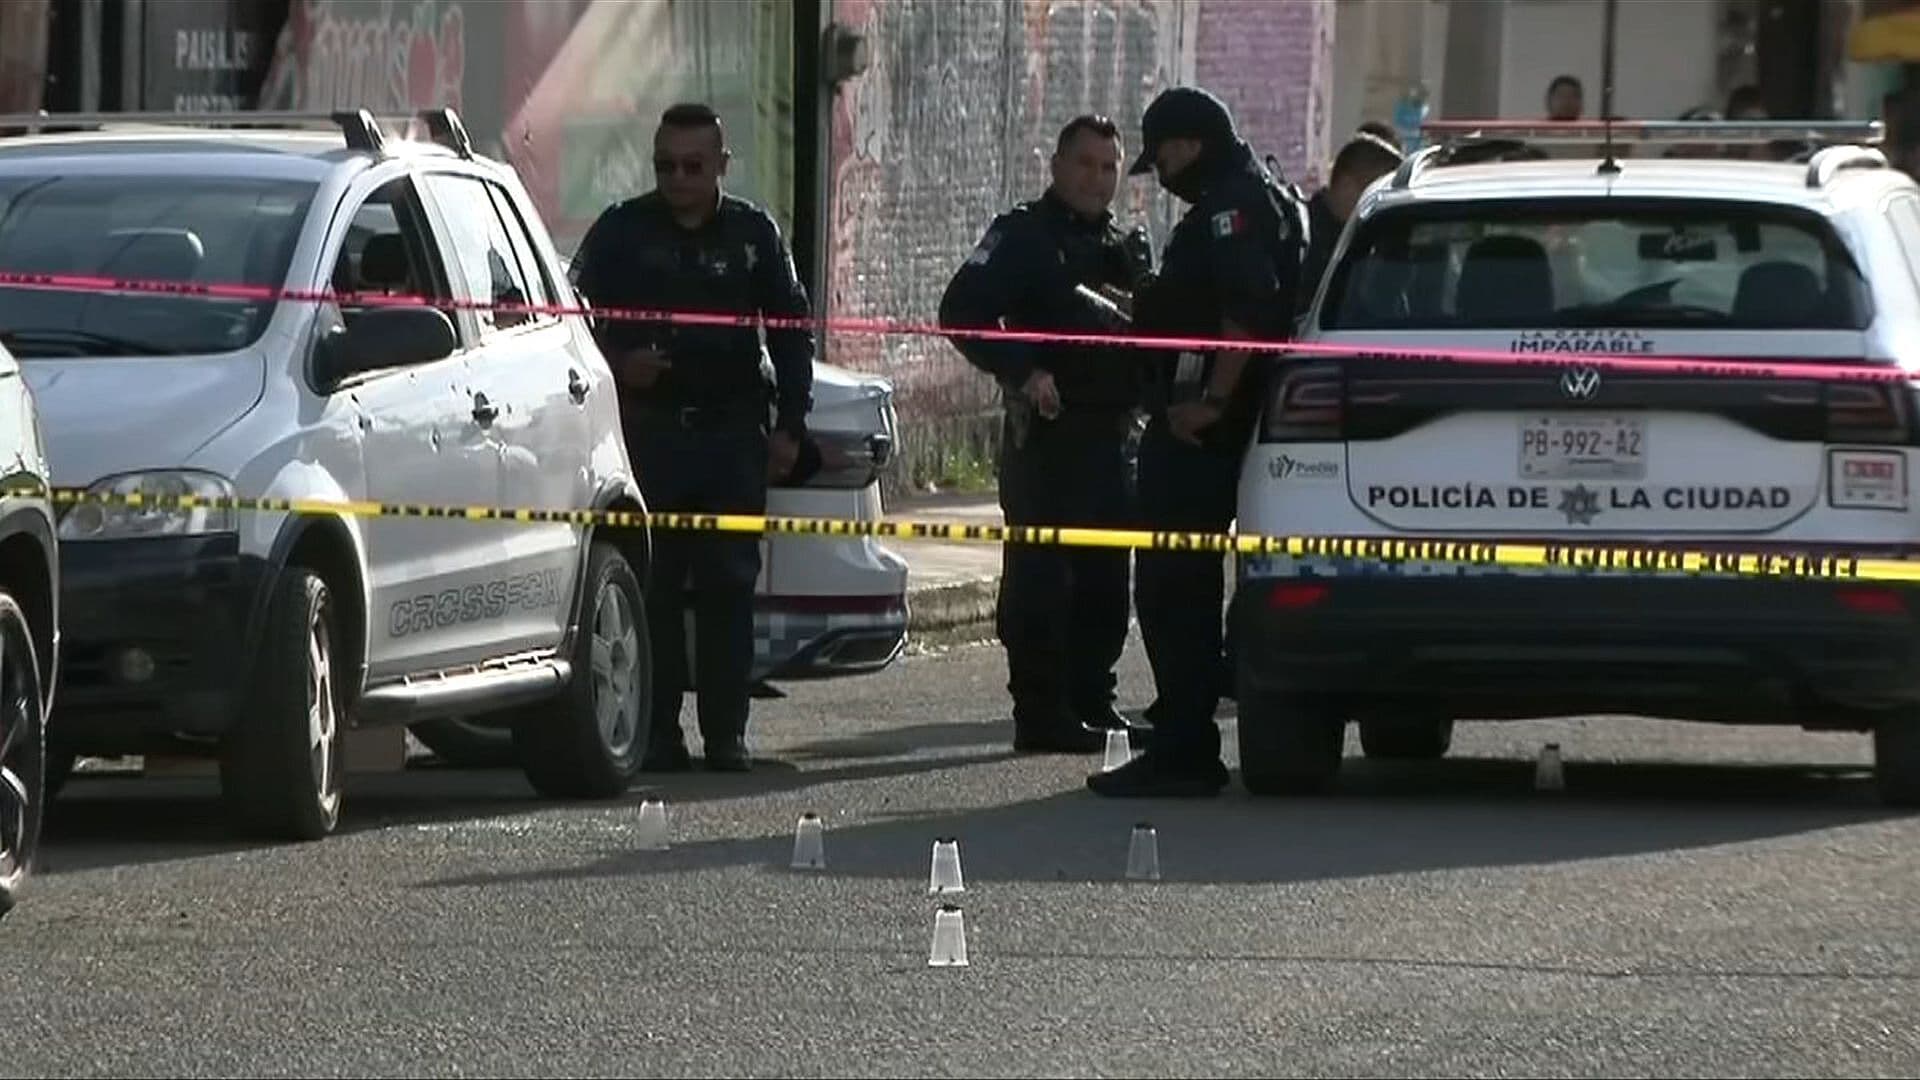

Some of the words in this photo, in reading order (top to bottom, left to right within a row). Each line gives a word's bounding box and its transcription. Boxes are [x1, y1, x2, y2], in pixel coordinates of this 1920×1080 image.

[1520, 329, 1543, 339] LA
[1555, 328, 1643, 339] CAPITAL
[1511, 340, 1655, 353] IMPARABLE
[1523, 429, 1641, 456] PB-992-A2
[1368, 481, 1496, 508] POLICÍA
[1507, 487, 1549, 508] DE
[1610, 487, 1651, 509] LA
[1663, 487, 1791, 509] CIUDAD
